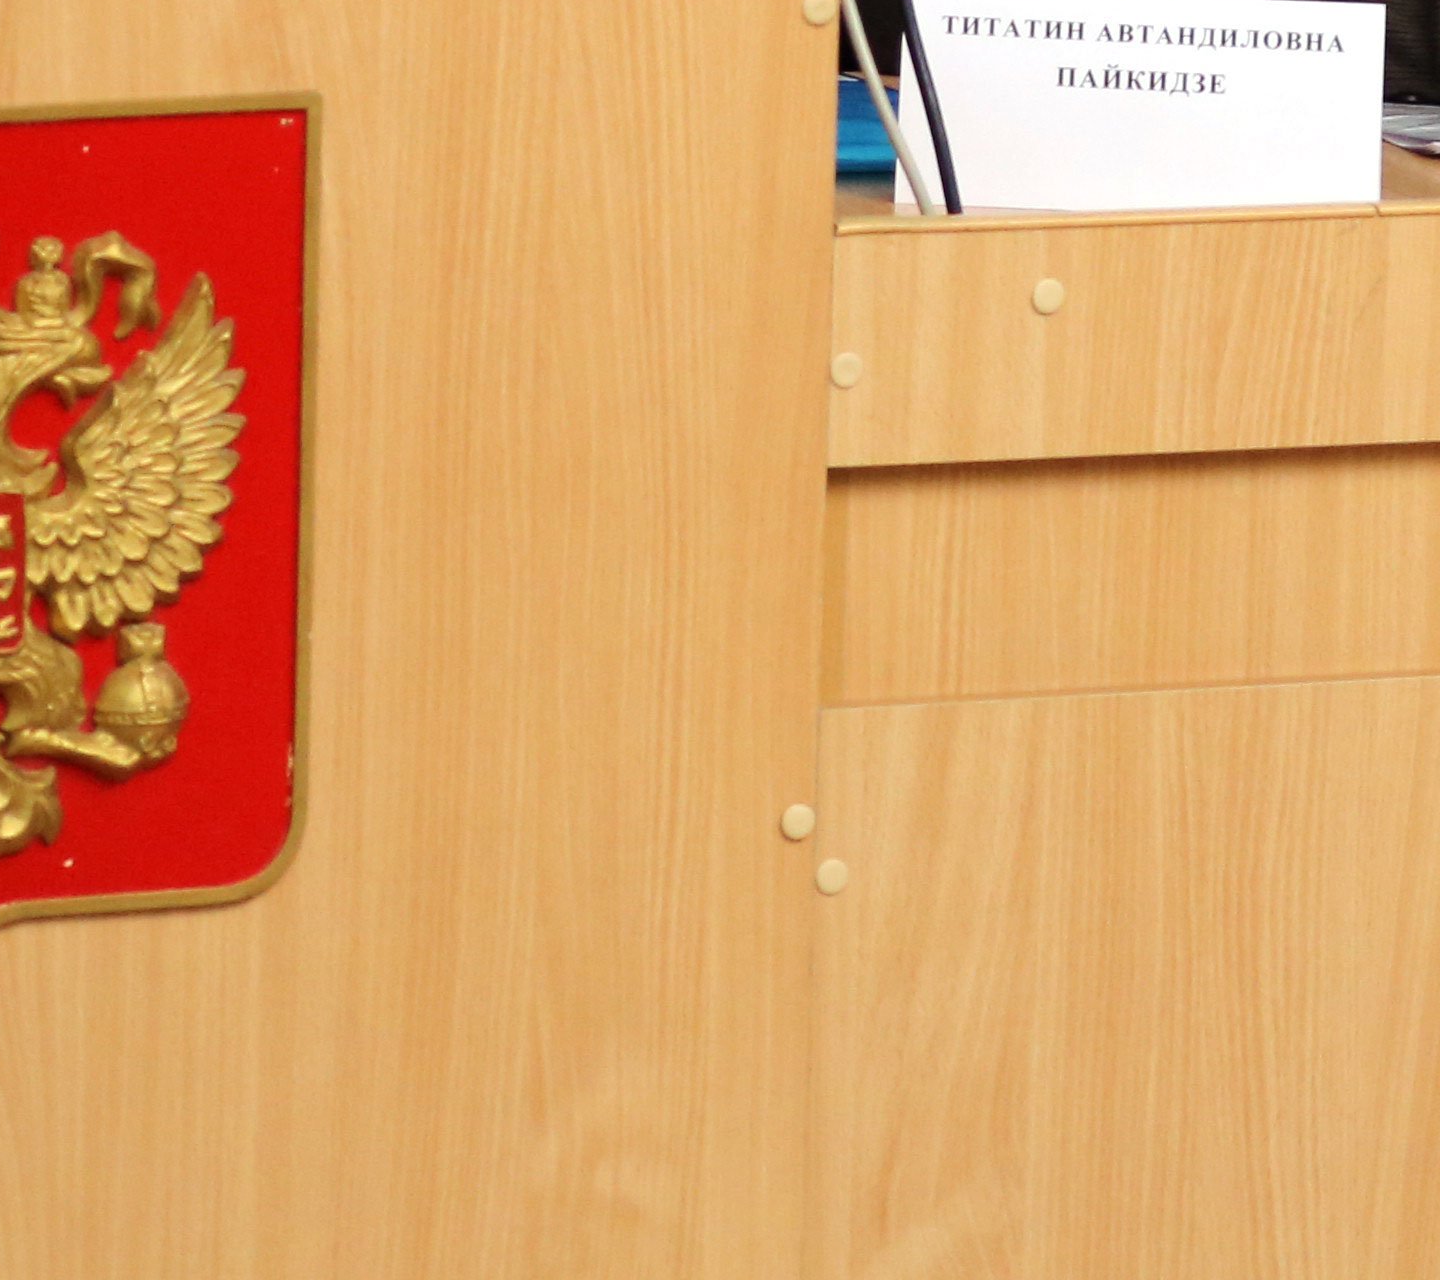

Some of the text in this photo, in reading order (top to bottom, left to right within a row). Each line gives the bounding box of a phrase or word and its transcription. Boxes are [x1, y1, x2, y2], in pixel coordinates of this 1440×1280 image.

[941, 14, 1346, 54] ТИТАТИН АВТАНДИЛОВНА
[1056, 63, 1228, 97] ПАЙКИДЗЕ
